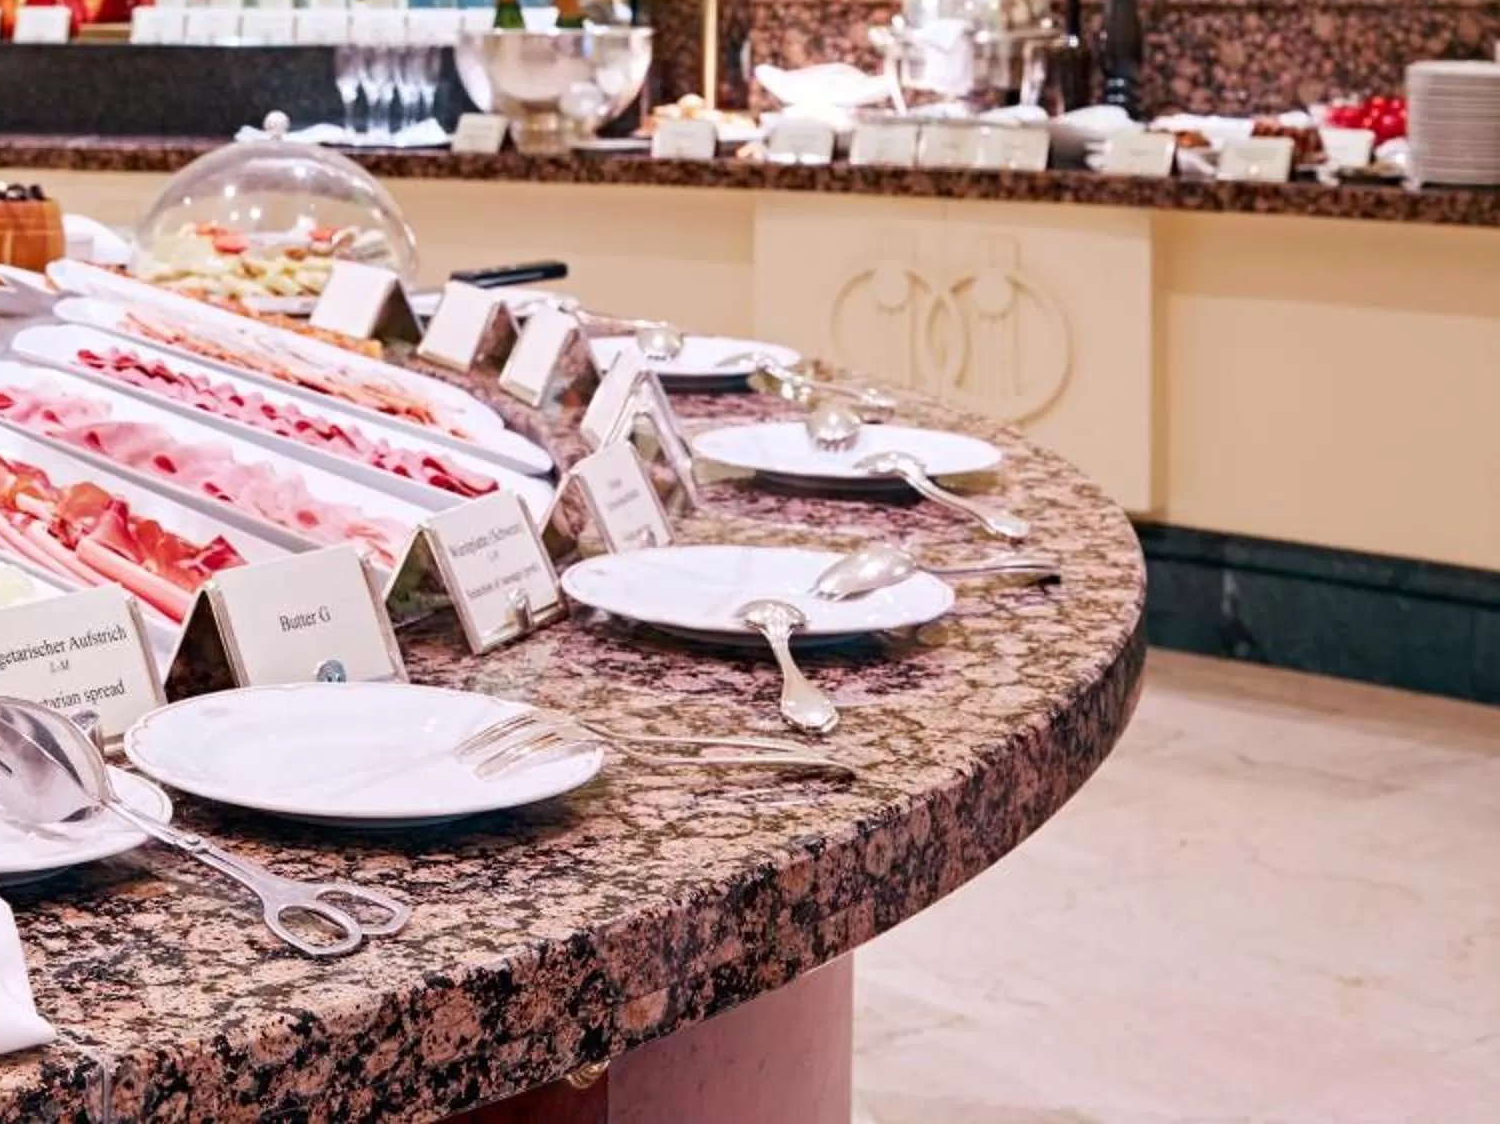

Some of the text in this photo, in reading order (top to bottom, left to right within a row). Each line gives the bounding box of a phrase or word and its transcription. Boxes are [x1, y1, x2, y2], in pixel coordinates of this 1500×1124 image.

[279, 612, 317, 632] Butter
[69, 624, 128, 652] Aufstrich
[83, 677, 126, 705] spread
